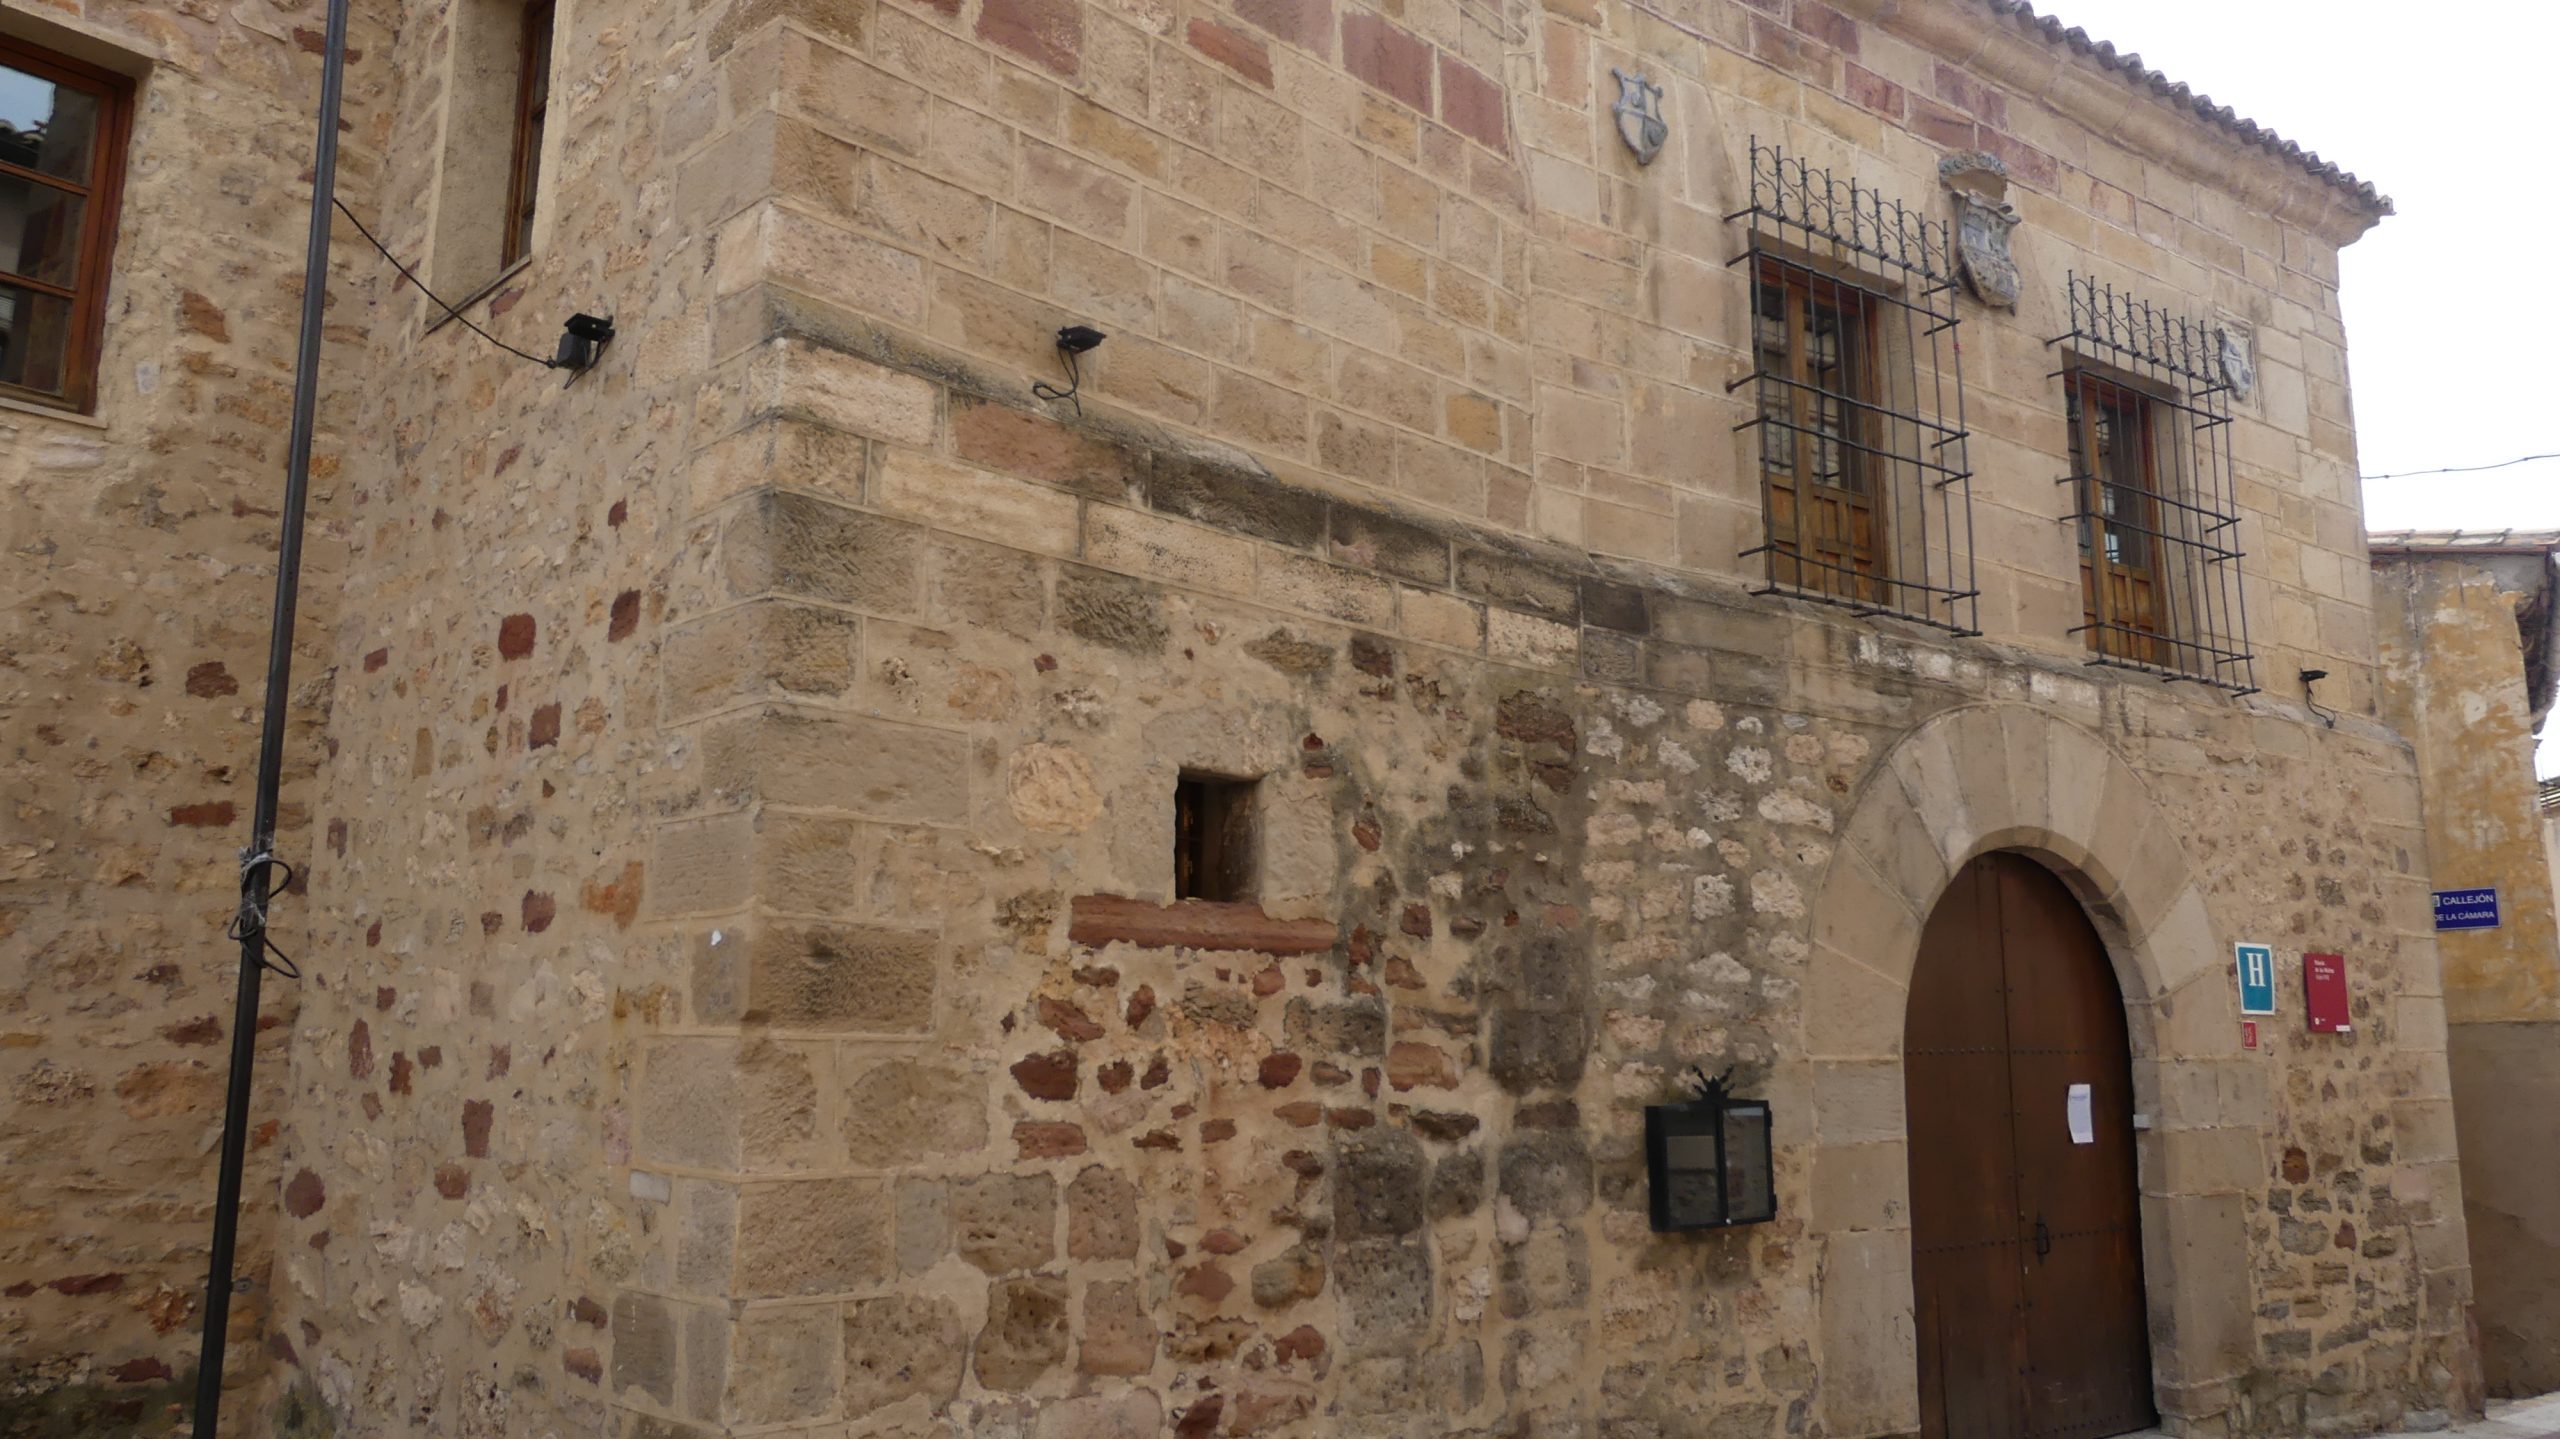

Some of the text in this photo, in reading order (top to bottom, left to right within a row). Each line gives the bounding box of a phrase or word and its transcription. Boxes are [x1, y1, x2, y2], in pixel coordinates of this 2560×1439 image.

[2442, 893, 2494, 905] CALLEJÓN
[2445, 913, 2457, 921] LA
[2458, 911, 2495, 920] CÁMARA
[2246, 953, 2266, 987] H
